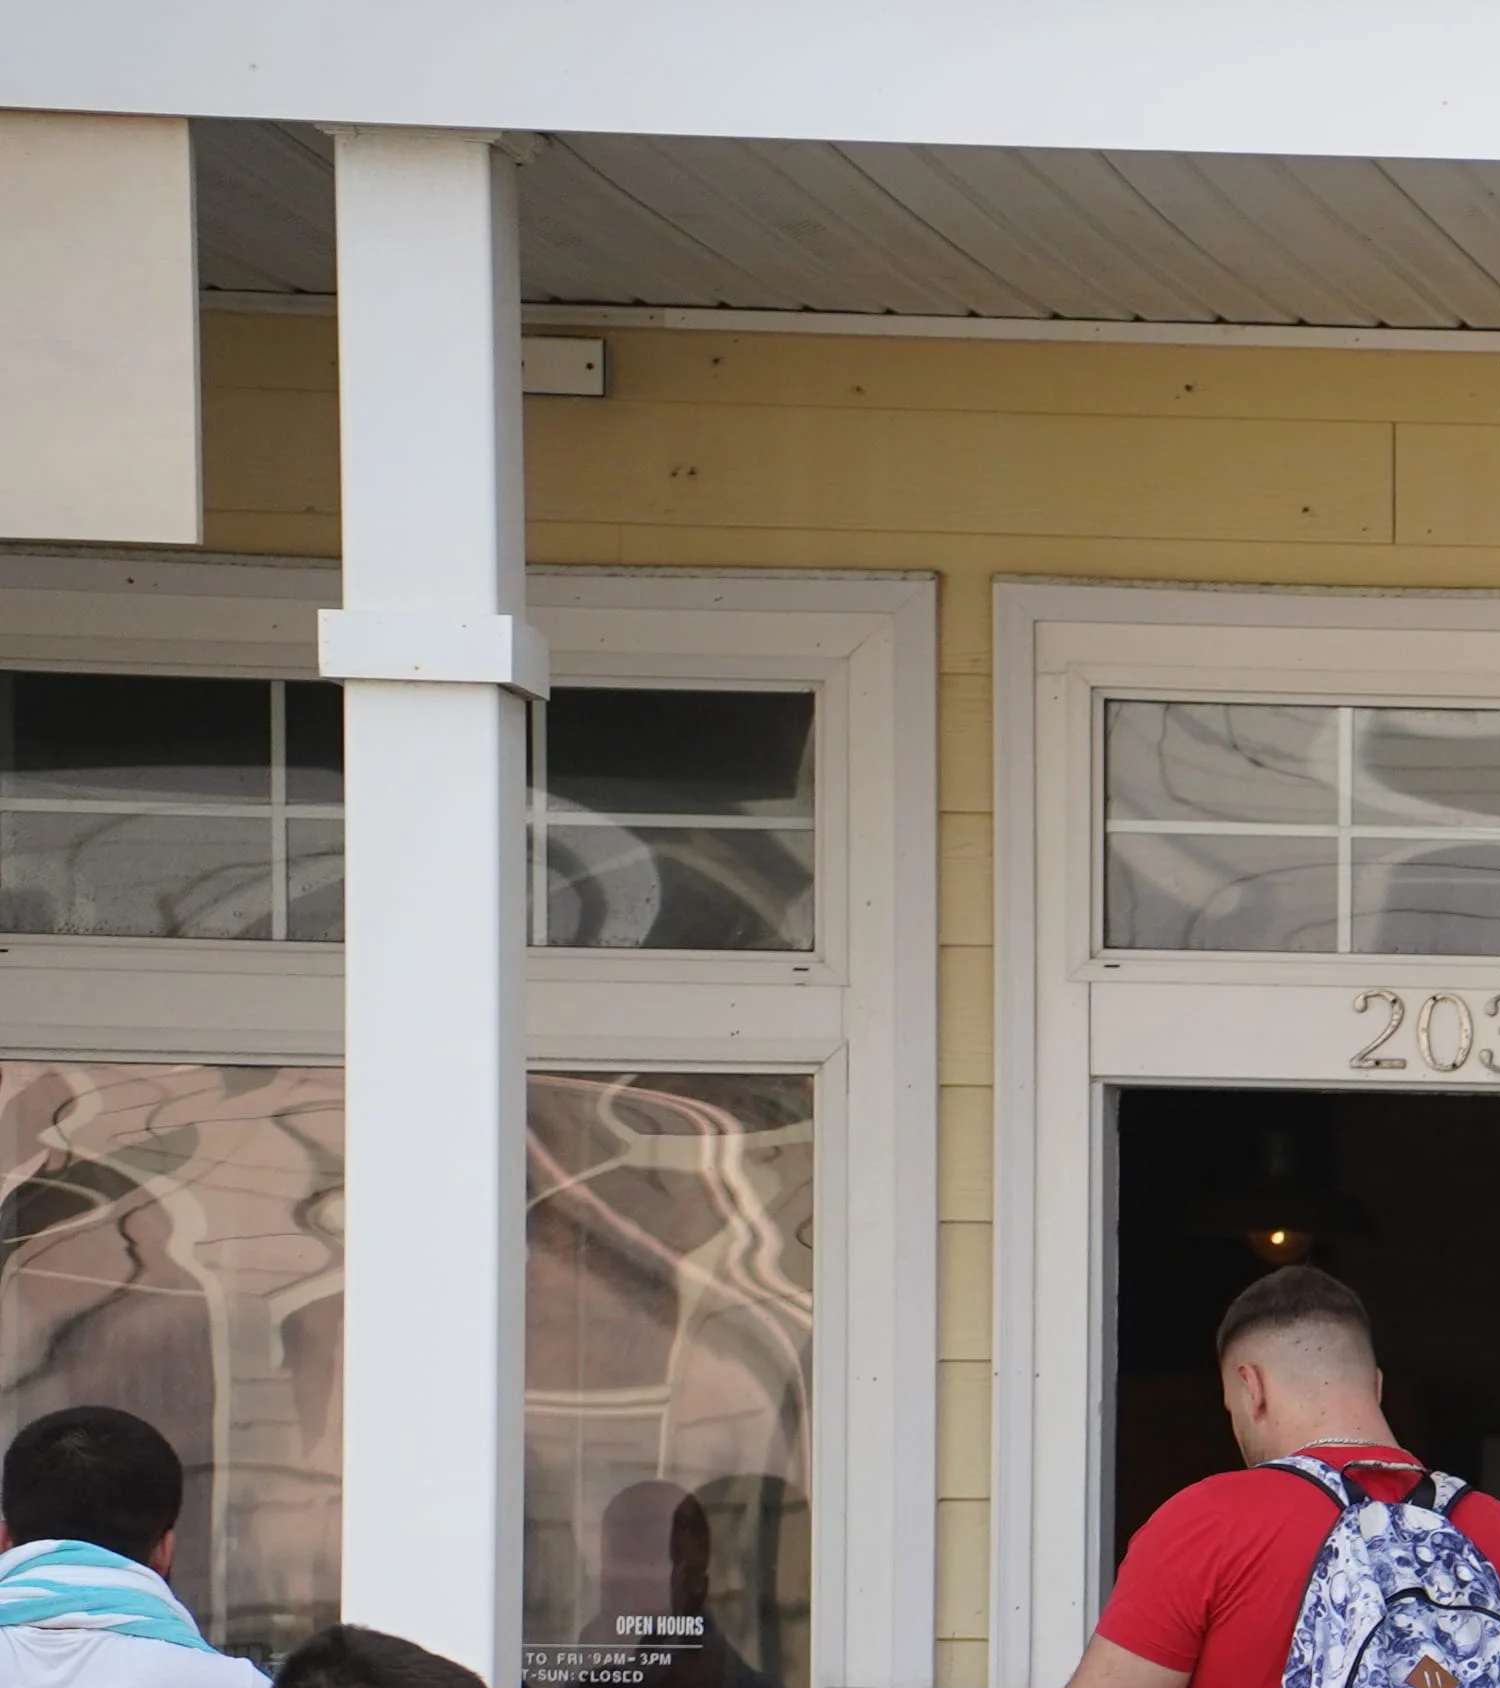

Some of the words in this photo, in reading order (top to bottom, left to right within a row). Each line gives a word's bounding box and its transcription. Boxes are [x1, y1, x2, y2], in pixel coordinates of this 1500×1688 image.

[616, 1615, 652, 1636] OPEN
[656, 1615, 705, 1637] HOURS
[525, 1652, 548, 1665] TO
[578, 1670, 644, 1684] CLOSED
